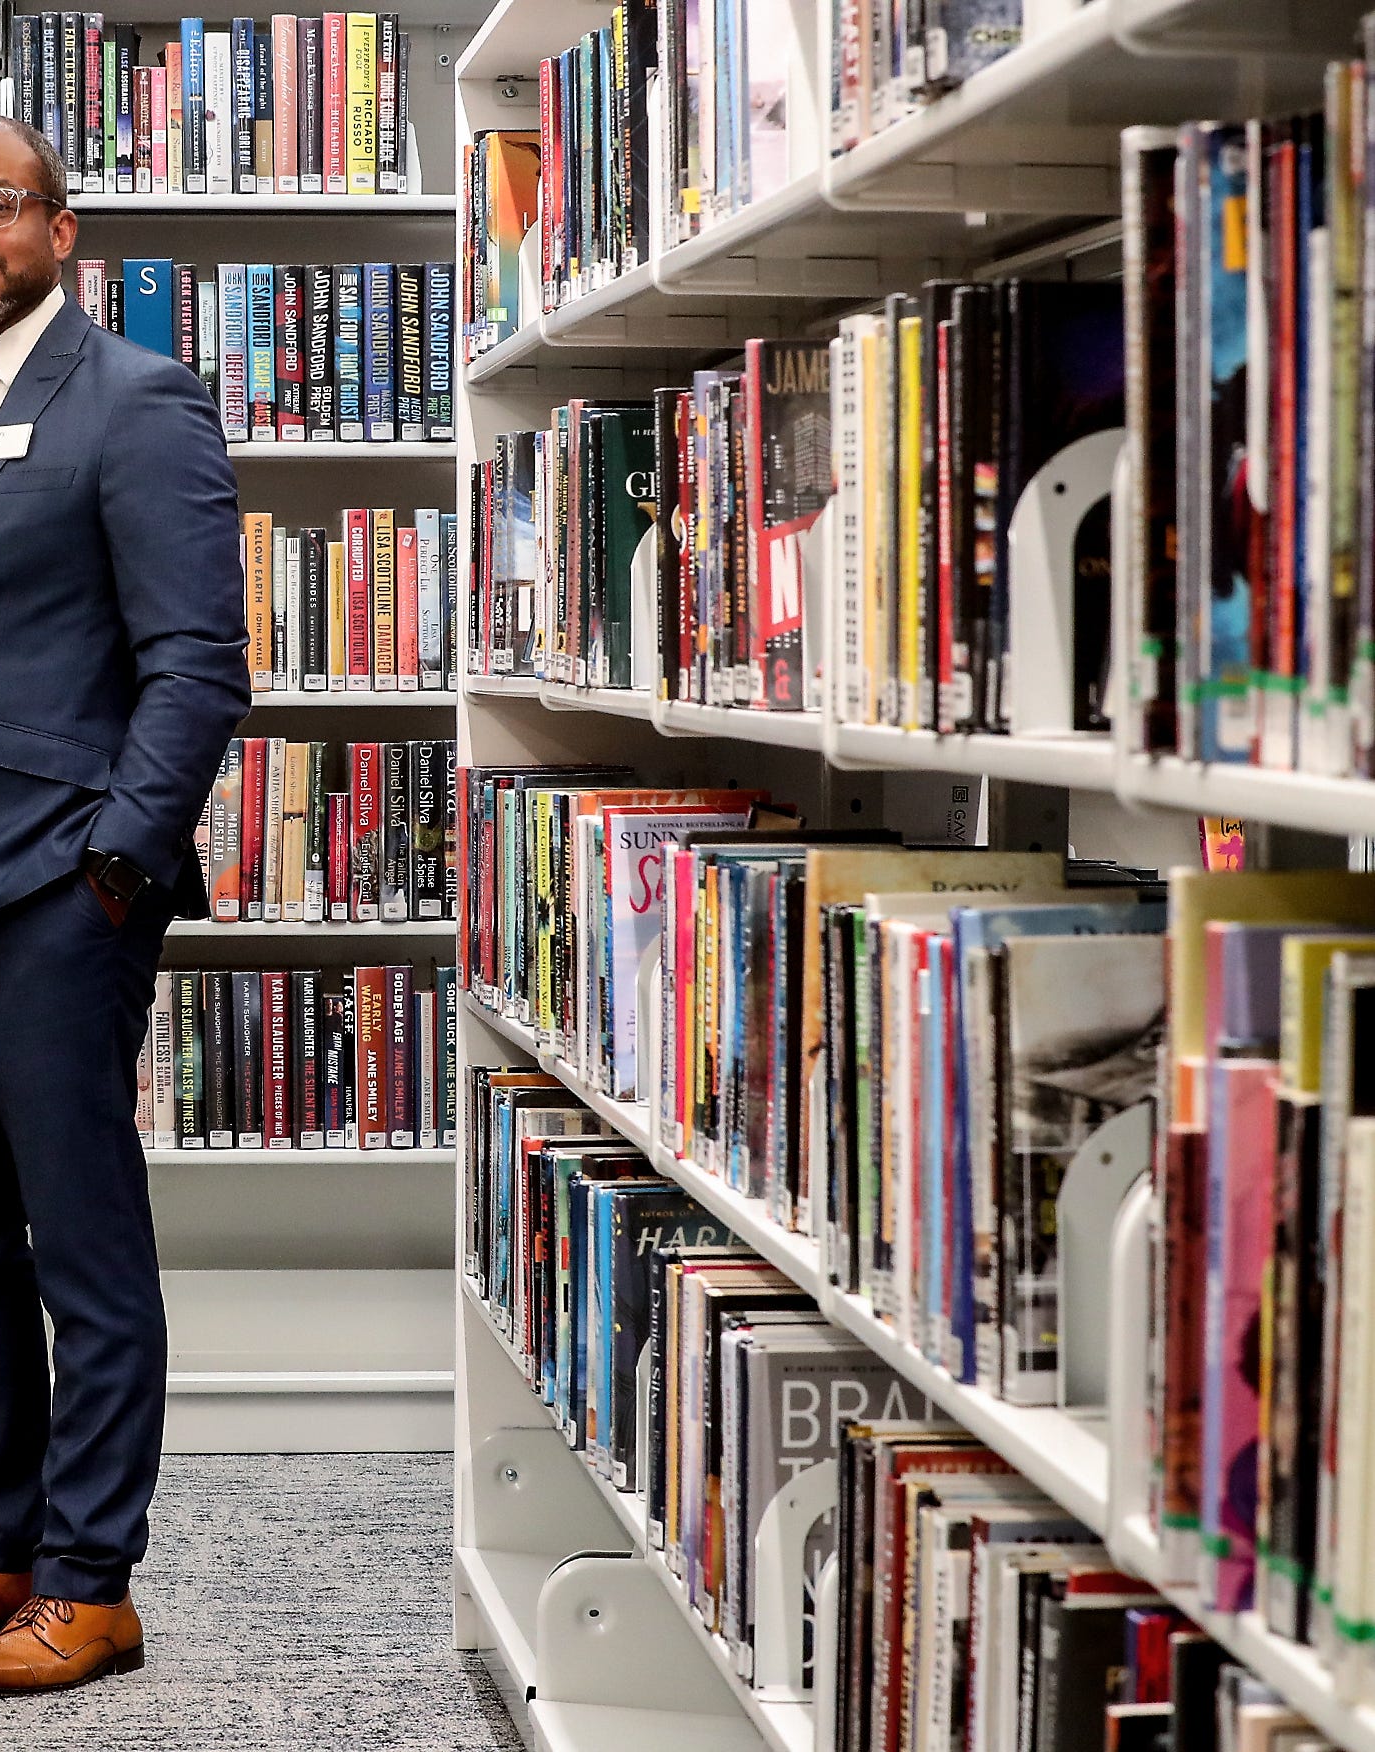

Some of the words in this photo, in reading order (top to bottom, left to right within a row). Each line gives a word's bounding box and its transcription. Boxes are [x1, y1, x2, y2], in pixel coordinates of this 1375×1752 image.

[65, 28, 75, 55] FADE
[65, 57, 75, 71] TO
[66, 75, 75, 105] BLACK
[139, 266, 158, 294] S
[180, 270, 192, 296] LOCK
[225, 273, 242, 285] JOHN
[285, 273, 297, 307] JOHN
[401, 273, 418, 313] JOHN
[431, 269, 449, 309] JOHN
[181, 299, 192, 332] EVERY
[225, 287, 242, 347] SANDFORD
[181, 335, 192, 363] DOOR
[285, 310, 297, 372] SANDFORD
[401, 315, 420, 394] SANDFORD
[430, 313, 449, 391] SANDFORD
[226, 353, 243, 380] DEEP
[226, 385, 243, 424] FREEZE
[397, 396, 410, 422] PREY
[411, 398, 421, 422] NEON
[254, 522, 262, 564] YELLOW
[351, 527, 363, 581] CORRUPTED
[377, 526, 385, 549] LISA
[254, 570, 262, 603] EARTH
[377, 553, 391, 616] SCOTTOLINE
[377, 624, 391, 673] DAMAGED
[360, 749, 372, 790] Daniel
[391, 749, 403, 788] Daniel
[360, 792, 372, 826] Silva
[391, 794, 405, 827] Silva
[214, 803, 223, 861] SHIPSTEAD
[227, 813, 237, 852] MAGGIE
[181, 980, 191, 1005] KARIN
[272, 979, 283, 1012] KARIN
[394, 973, 403, 1016] GOLDEN
[447, 983, 455, 1015] SOME
[361, 985, 371, 1042] WARNING
[373, 994, 381, 1032] EARLY
[182, 1008, 192, 1059] SLAUGHTER
[272, 1016, 284, 1080] SLAUGHTER
[394, 1020, 403, 1043] AGE
[446, 1020, 455, 1047] LUCK
[182, 1062, 193, 1089] FALSE
[367, 1050, 376, 1076] JANE
[447, 1051, 455, 1077] JANE
[183, 1092, 194, 1133] WITNESS
[367, 1080, 377, 1122] SMILEY
[446, 1080, 455, 1122] SMILEY
[651, 1369, 661, 1418] Silva
